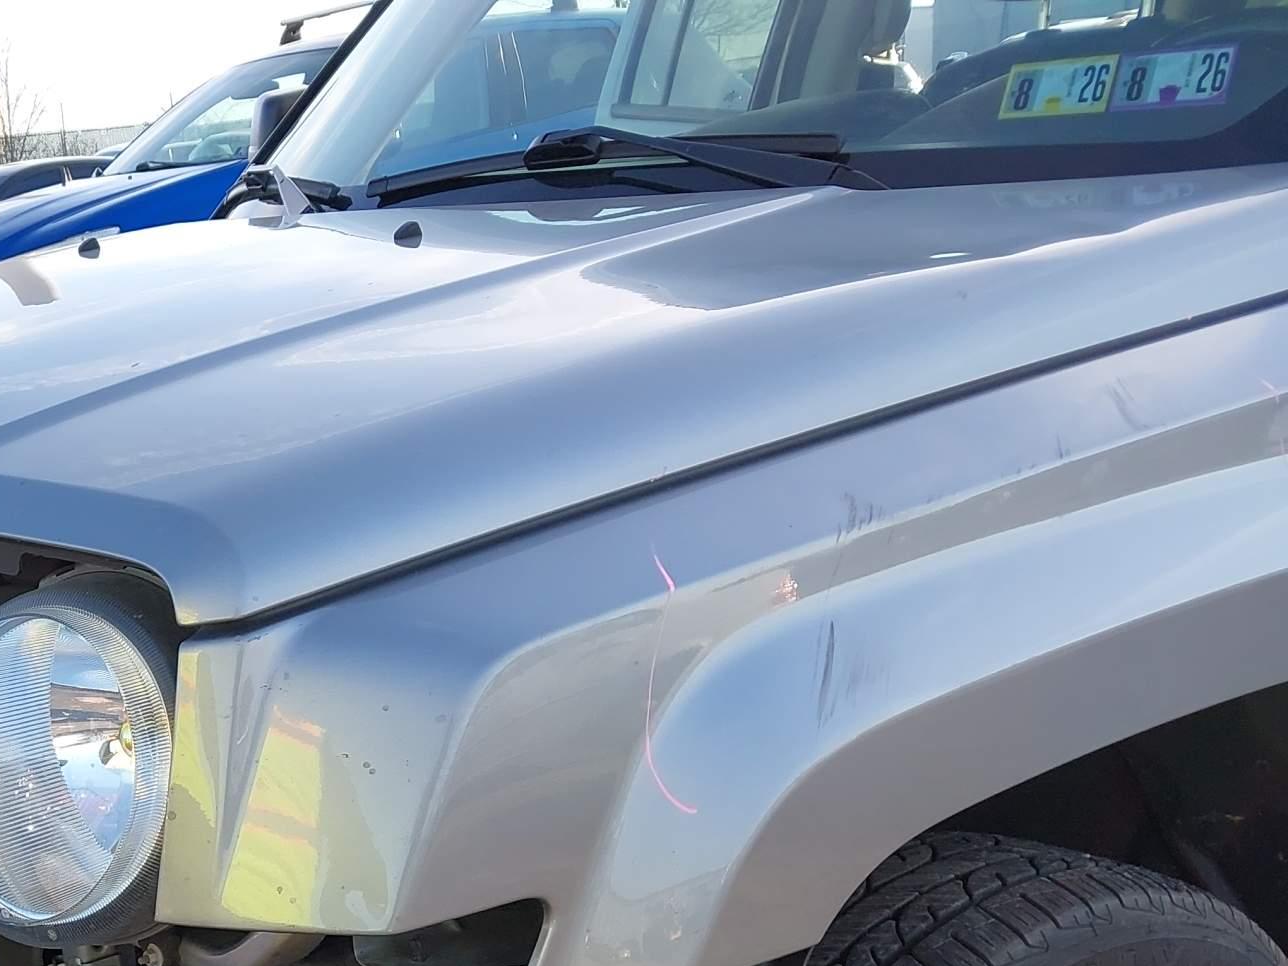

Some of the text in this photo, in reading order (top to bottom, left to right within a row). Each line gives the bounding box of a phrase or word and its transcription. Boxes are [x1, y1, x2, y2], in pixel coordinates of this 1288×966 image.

[1013, 78, 1034, 110] 8
[1078, 63, 1111, 103] 26
[1126, 67, 1148, 101] 8
[1195, 52, 1230, 93] 26
